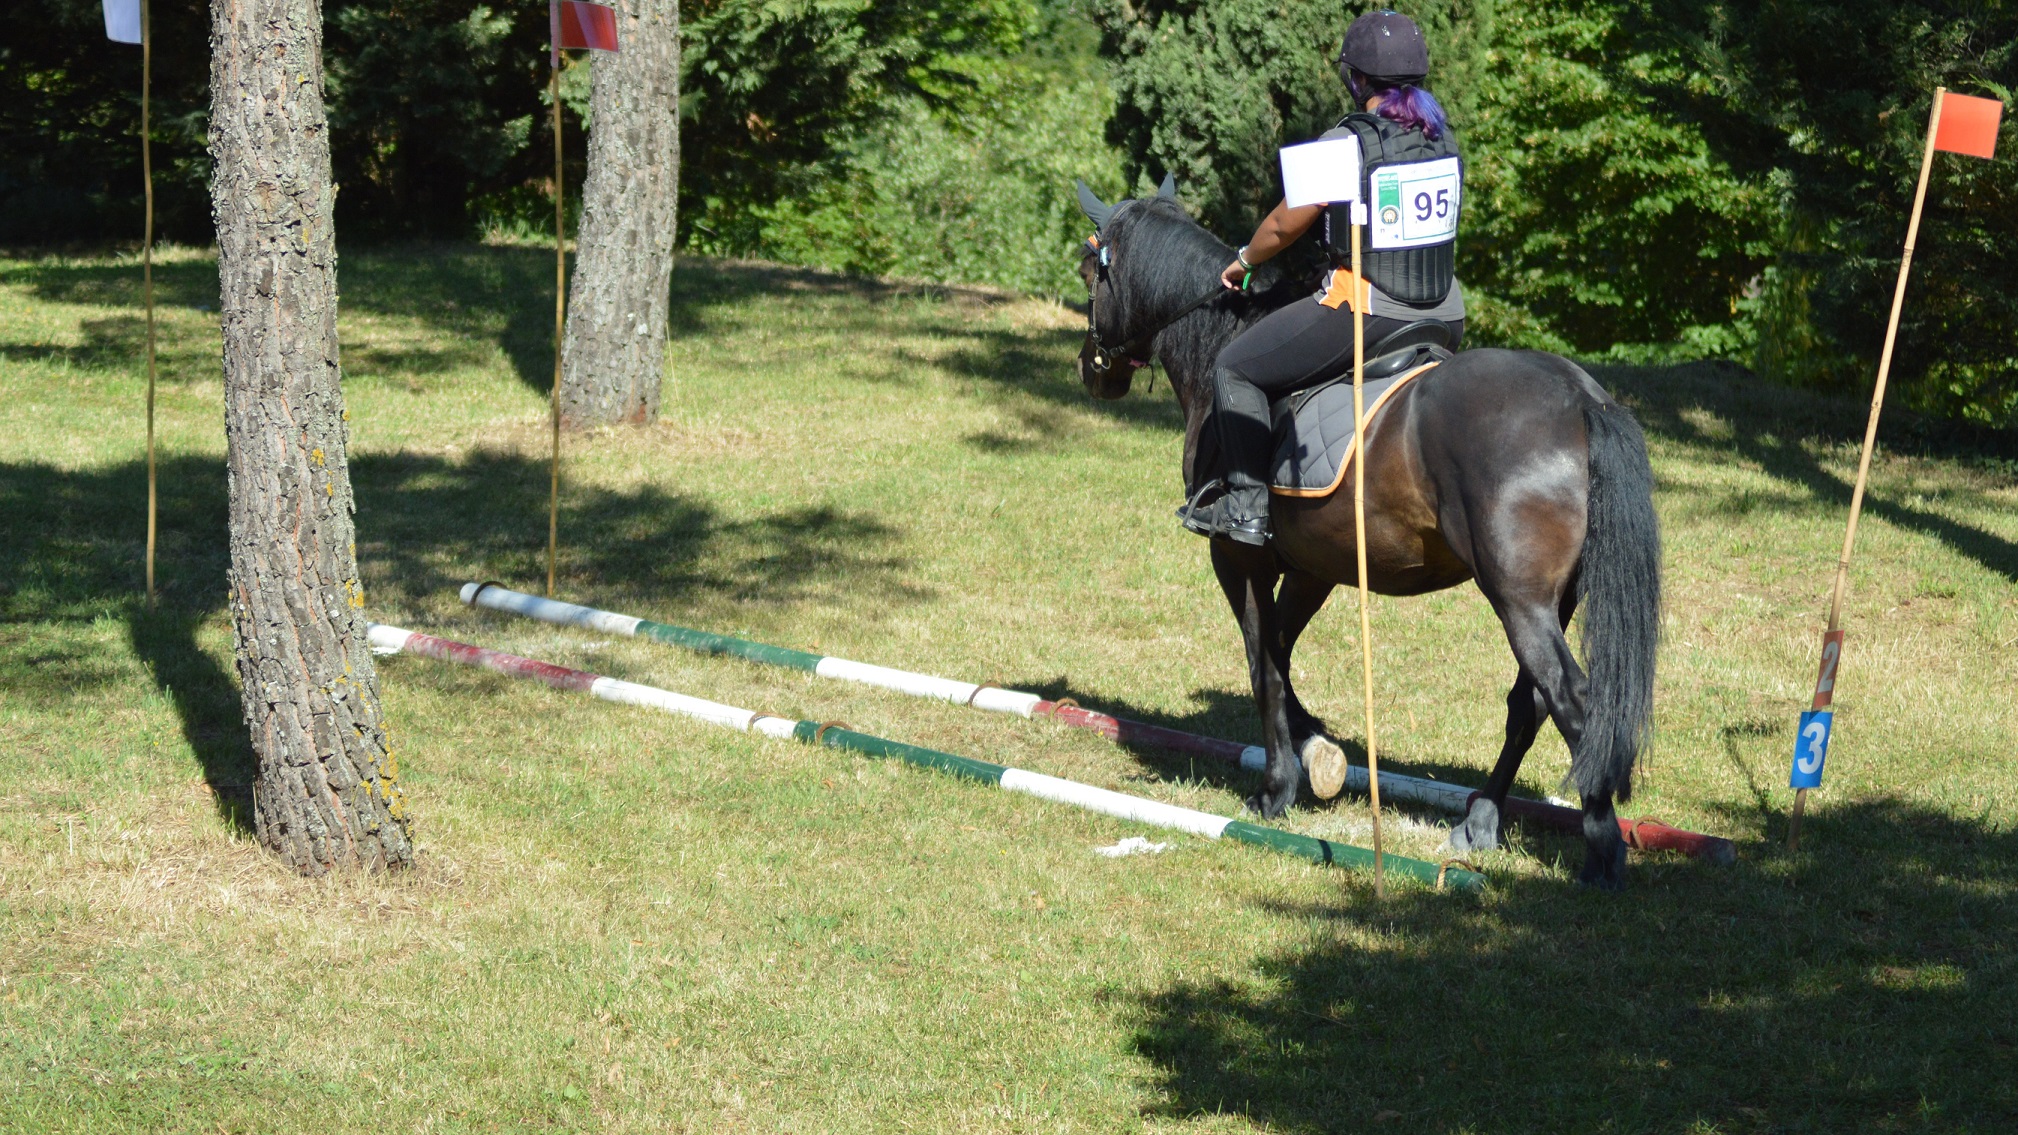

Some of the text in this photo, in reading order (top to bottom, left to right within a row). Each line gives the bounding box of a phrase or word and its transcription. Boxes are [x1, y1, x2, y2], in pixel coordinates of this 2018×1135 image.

[1414, 189, 1449, 222] 95
[1817, 640, 1839, 693] 2
[1797, 722, 1826, 775] 3
